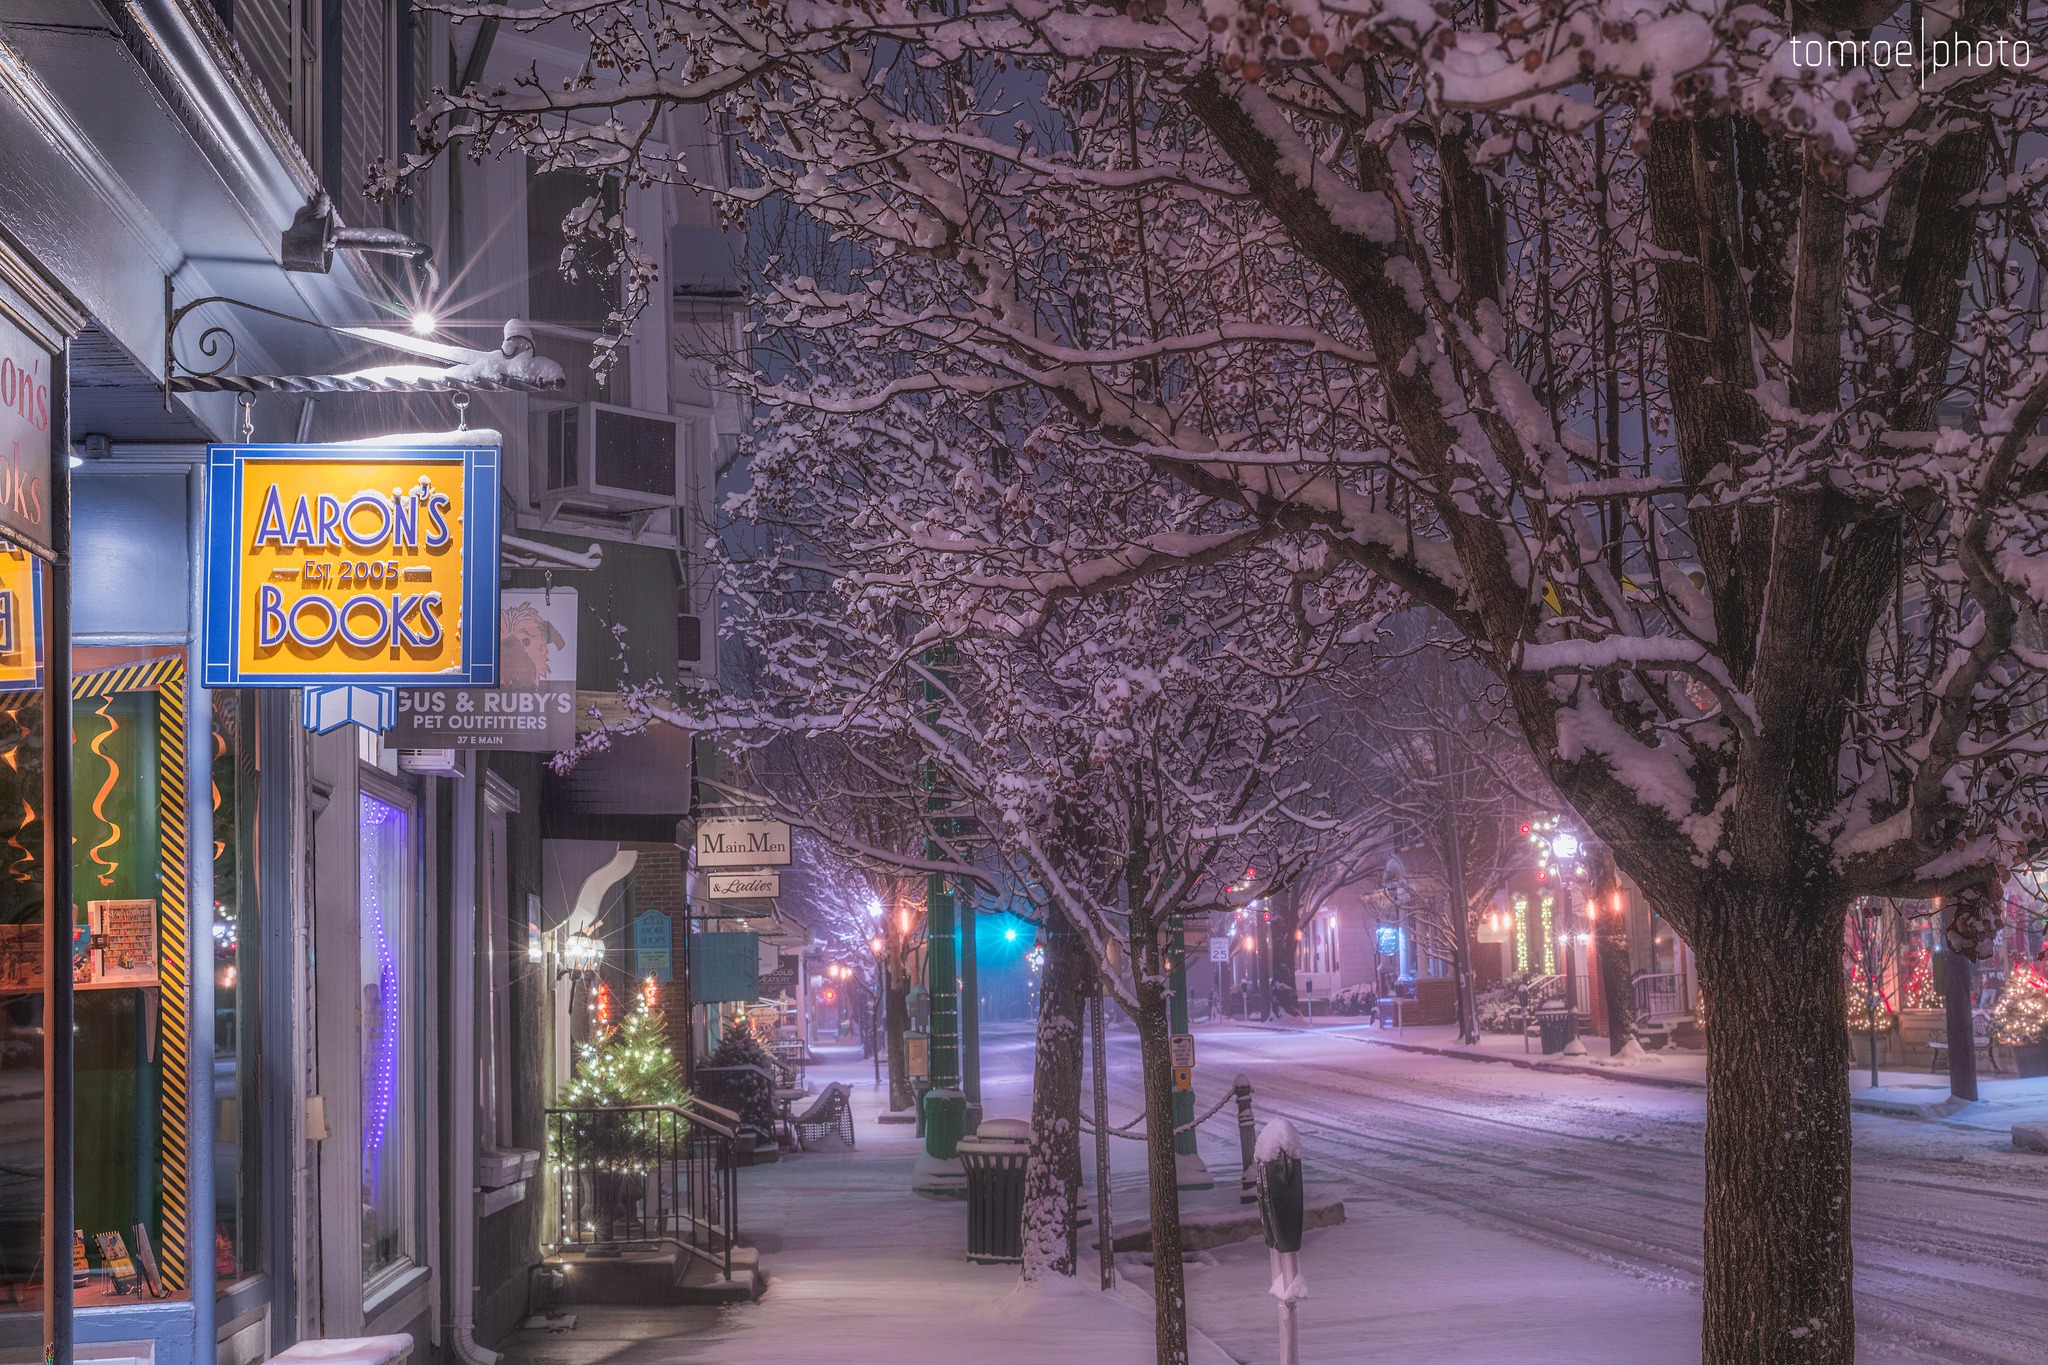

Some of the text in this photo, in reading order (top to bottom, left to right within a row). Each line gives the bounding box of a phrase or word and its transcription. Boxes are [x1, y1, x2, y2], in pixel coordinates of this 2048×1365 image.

[340, 560, 399, 580] 2005
[258, 583, 444, 648] BOOKS
[455, 691, 475, 713] &
[484, 692, 572, 714] RUBY'S
[413, 715, 547, 730] PET OUTFITTERS
[456, 736, 503, 745] 37 E MAIN
[713, 879, 773, 894] & Ladies
[641, 926, 664, 935] MORE
[640, 935, 666, 945] SHOPS
[1212, 950, 1227, 959] 25
